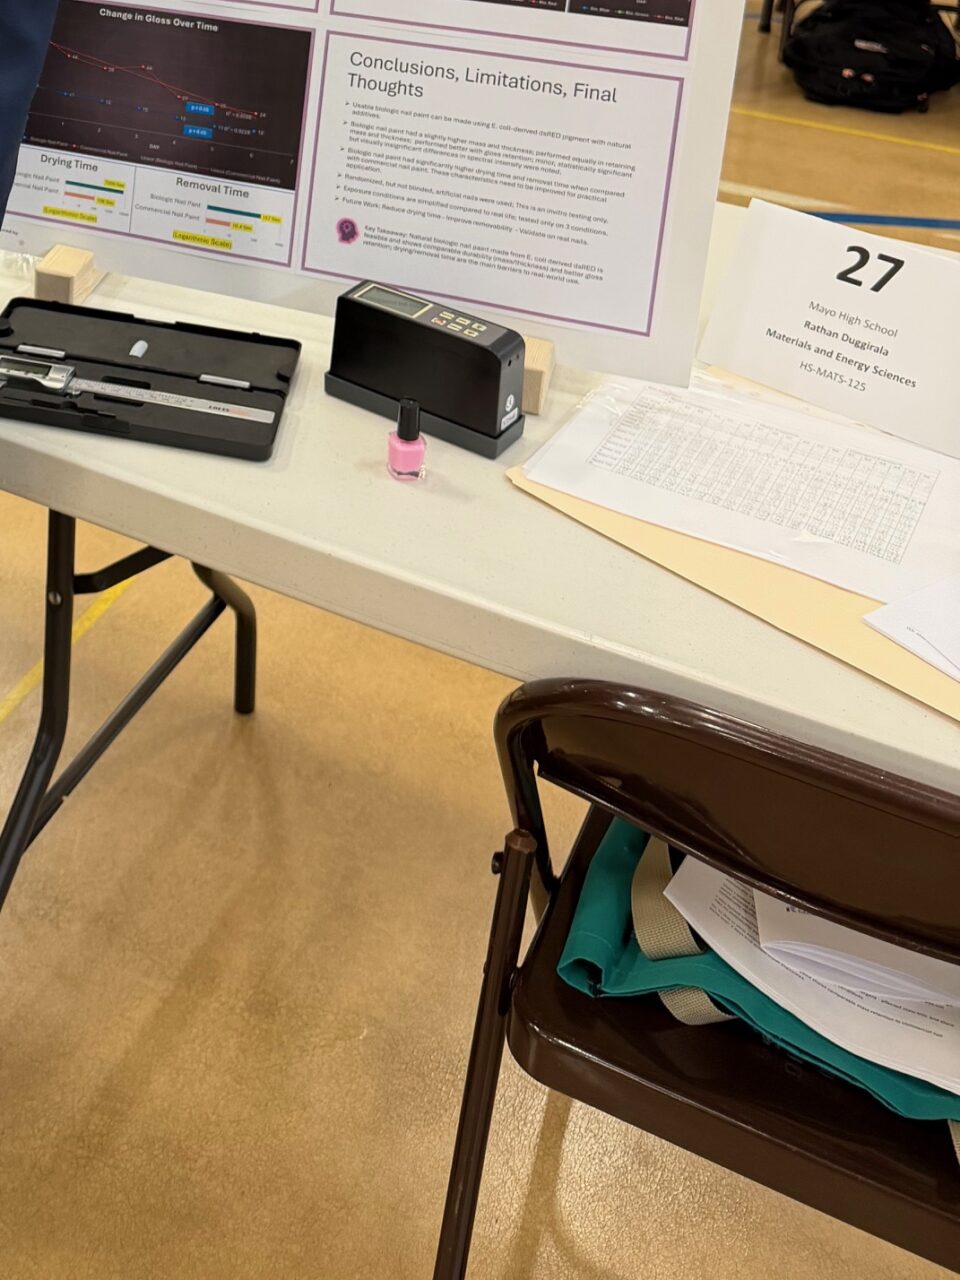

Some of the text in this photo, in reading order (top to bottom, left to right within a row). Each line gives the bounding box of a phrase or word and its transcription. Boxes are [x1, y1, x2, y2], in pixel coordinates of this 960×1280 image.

[100, 8, 219, 32] Change in Gloss Over Time
[348, 72, 424, 98] Thoughts
[350, 52, 617, 103] Conclusions, Limitations, Final
[40, 154, 98, 172] Drying Time
[176, 177, 250, 198] Removal Time
[836, 245, 905, 293] 27
[809, 301, 898, 338] Mayo High School
[804, 320, 889, 357] Rathan Duggirala
[766, 328, 917, 388] Materials and Energy Sciences
[800, 361, 866, 392] HS-MATS-125
